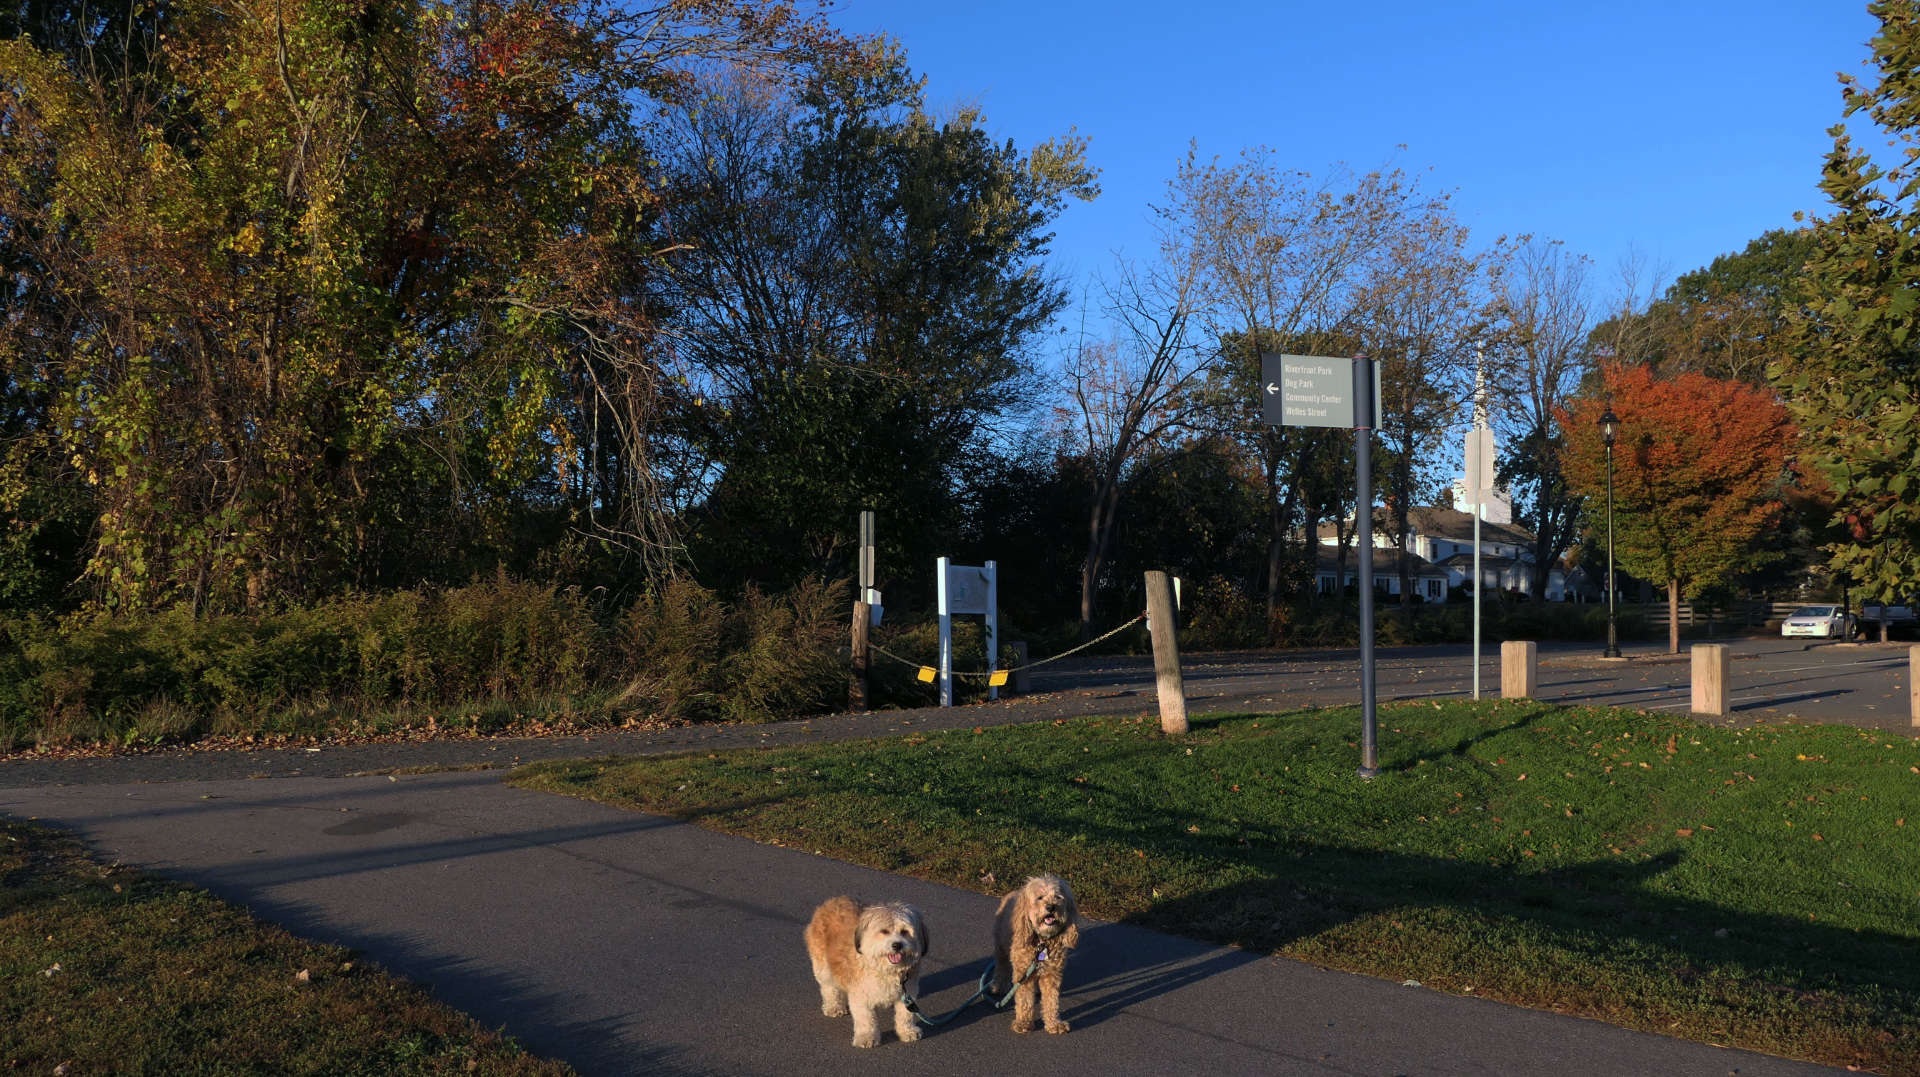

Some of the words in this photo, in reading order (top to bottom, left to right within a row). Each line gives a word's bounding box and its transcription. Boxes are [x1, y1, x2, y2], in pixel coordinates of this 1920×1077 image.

[1318, 366, 1332, 376] Park
[1285, 378, 1298, 389] Dog
[1299, 379, 1313, 388] Park
[1286, 392, 1319, 405] Community
[1307, 407, 1327, 417] Street
